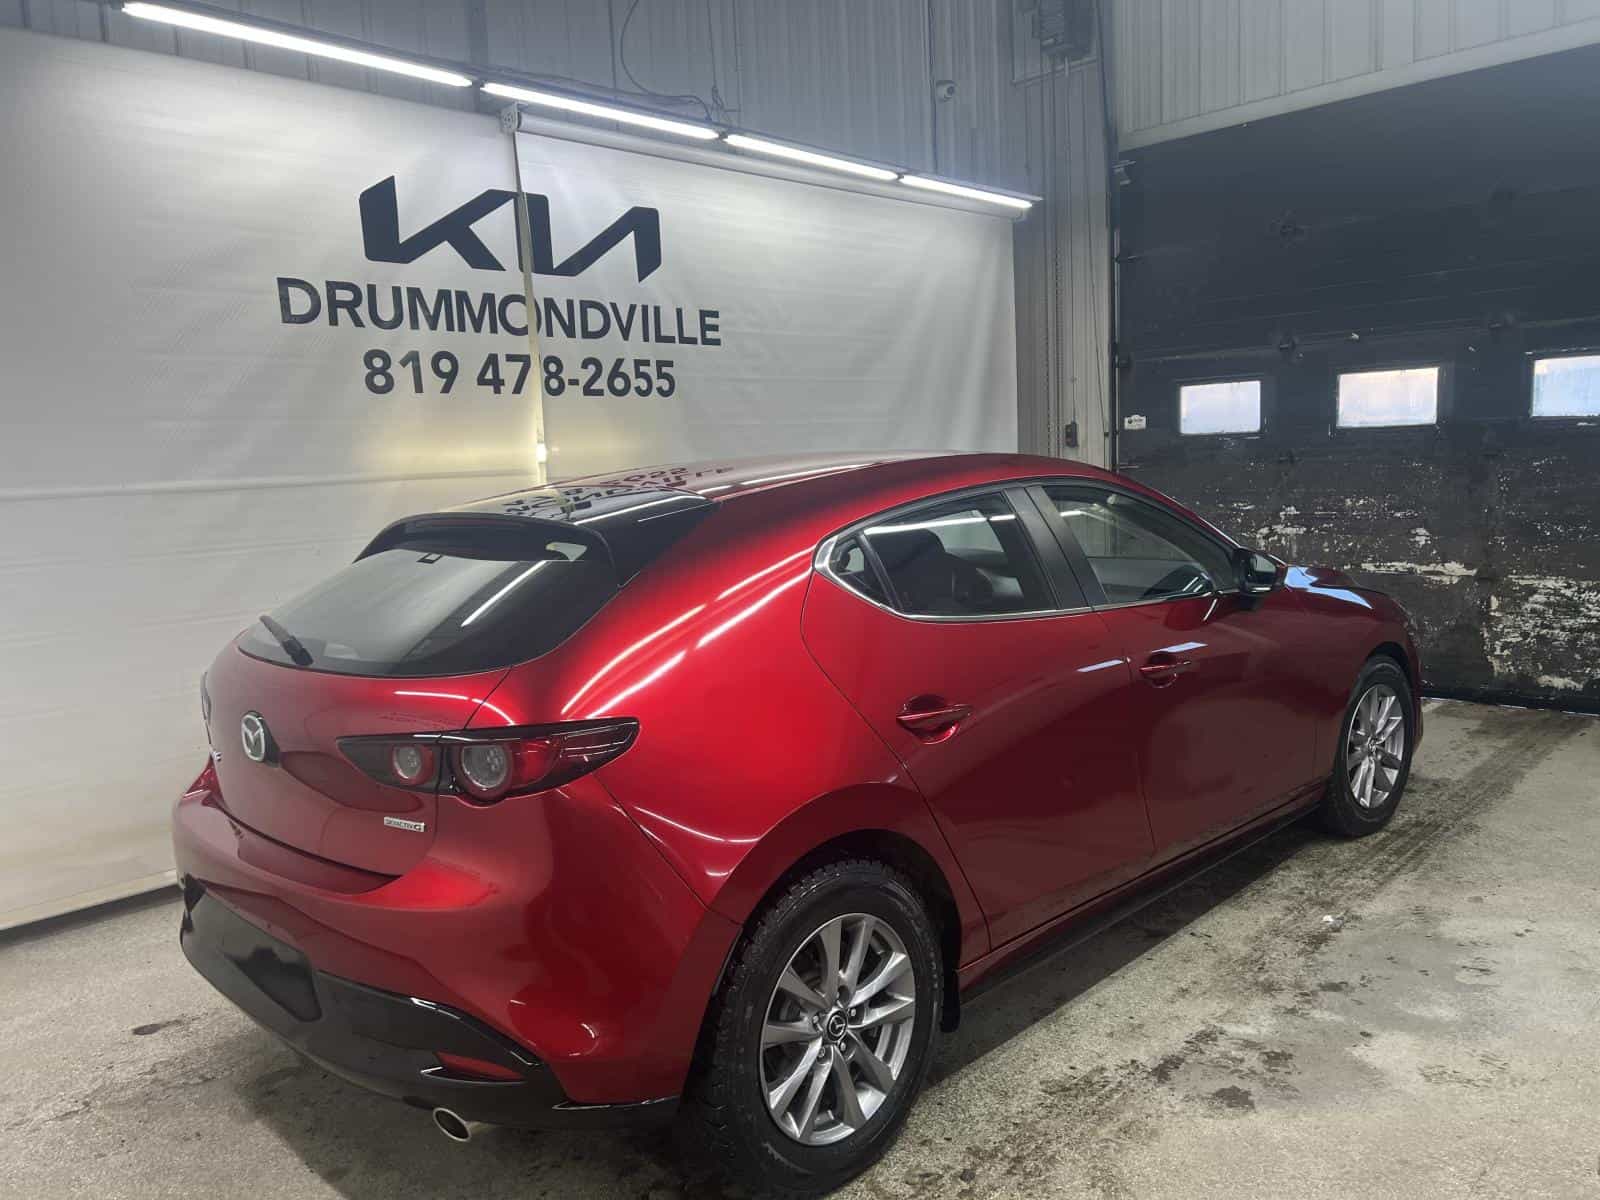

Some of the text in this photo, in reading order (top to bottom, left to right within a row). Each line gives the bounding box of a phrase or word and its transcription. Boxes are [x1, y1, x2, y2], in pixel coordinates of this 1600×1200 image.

[276, 276, 722, 346] DRUMMONDVILLE
[363, 349, 677, 398] 819 478-2655
